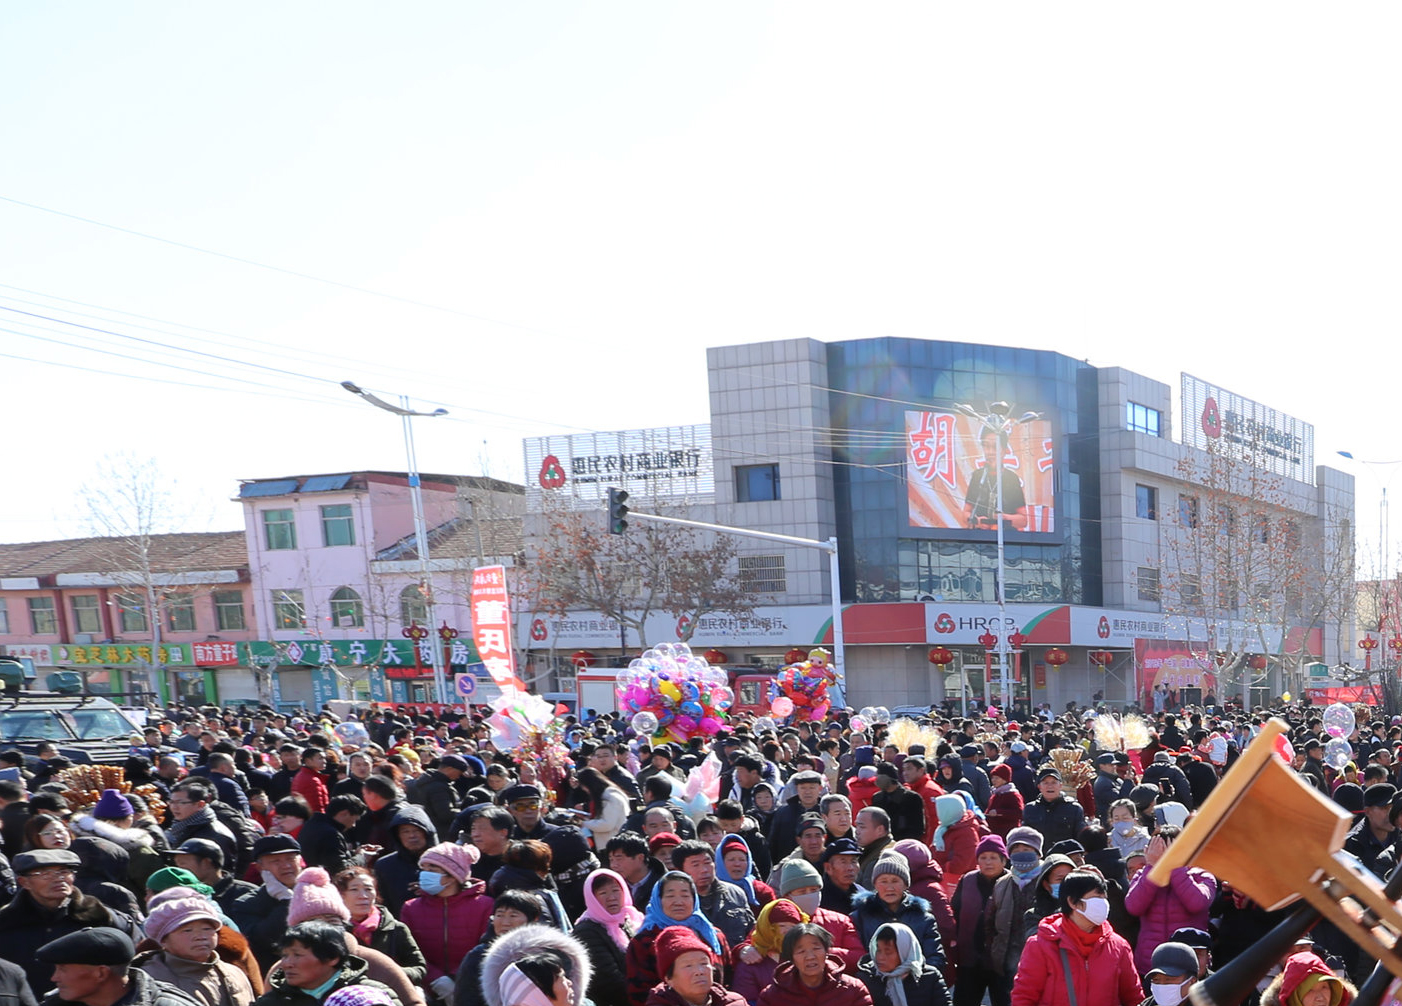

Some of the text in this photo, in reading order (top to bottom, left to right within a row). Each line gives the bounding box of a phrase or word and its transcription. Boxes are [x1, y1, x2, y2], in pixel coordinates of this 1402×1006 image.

[572, 449, 700, 474] 惠民农村商业银行
[959, 617, 1016, 631] HRCB
[1112, 619, 1167, 633] 惠民农村商业银行
